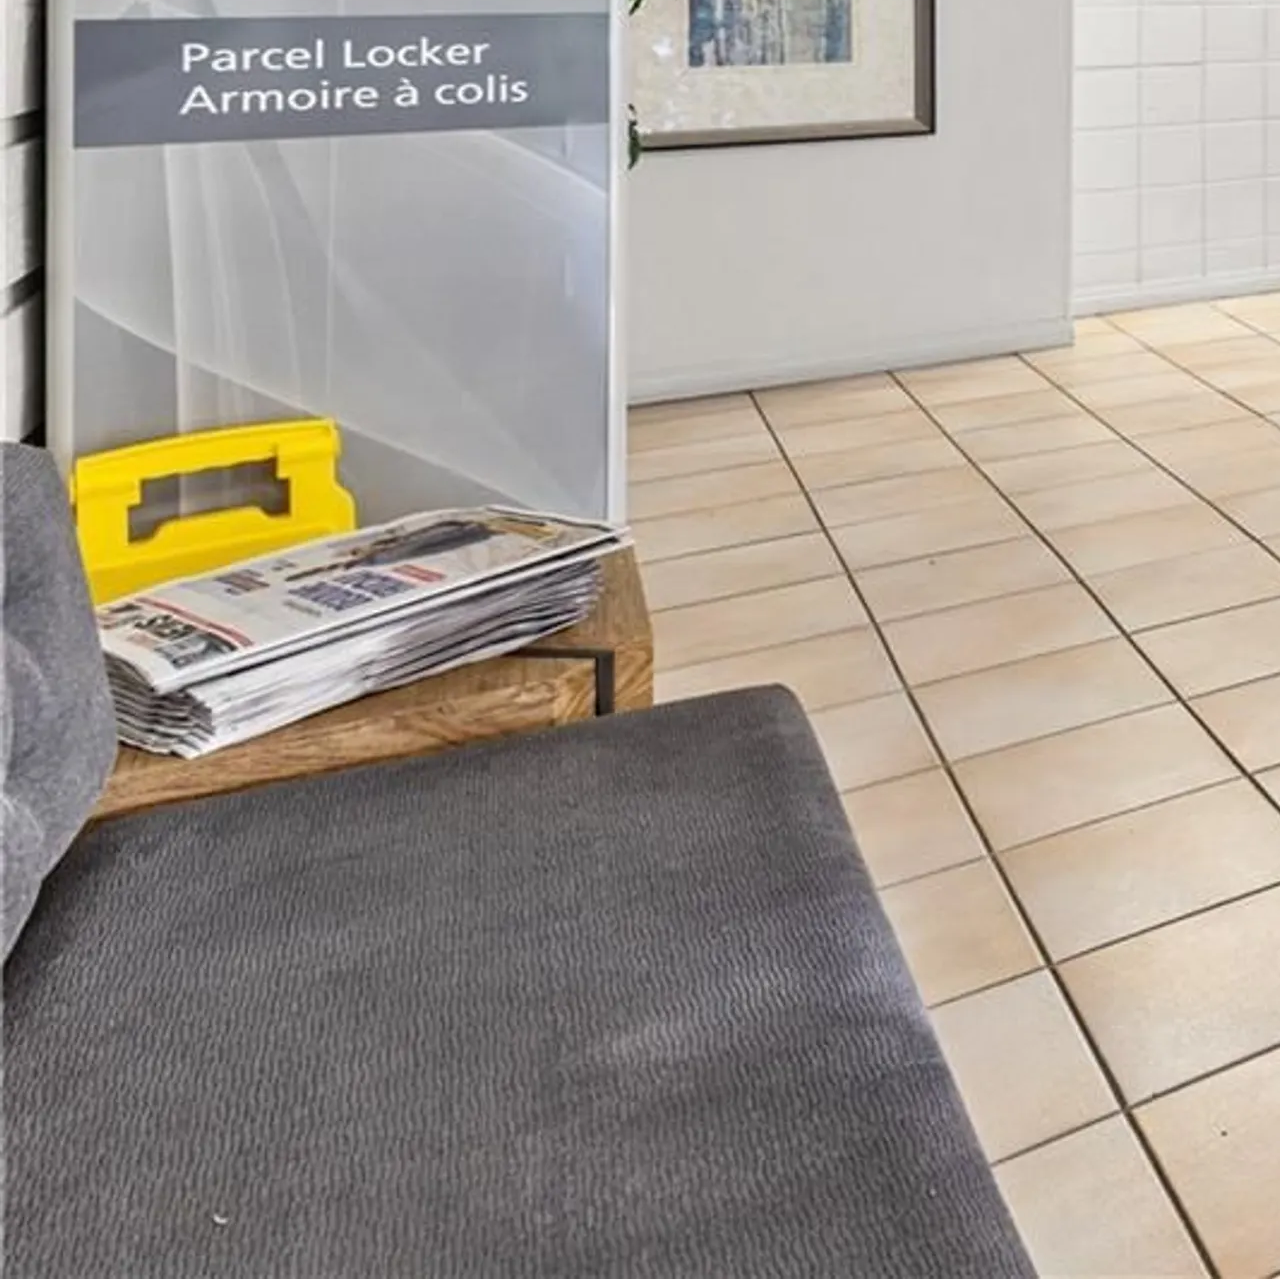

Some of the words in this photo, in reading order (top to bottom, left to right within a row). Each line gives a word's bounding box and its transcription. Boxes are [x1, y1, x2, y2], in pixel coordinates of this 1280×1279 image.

[181, 38, 324, 73] Parcel
[343, 36, 490, 69] Locker
[179, 80, 380, 115] Armoire
[394, 77, 420, 108] à
[434, 74, 529, 106] colis
